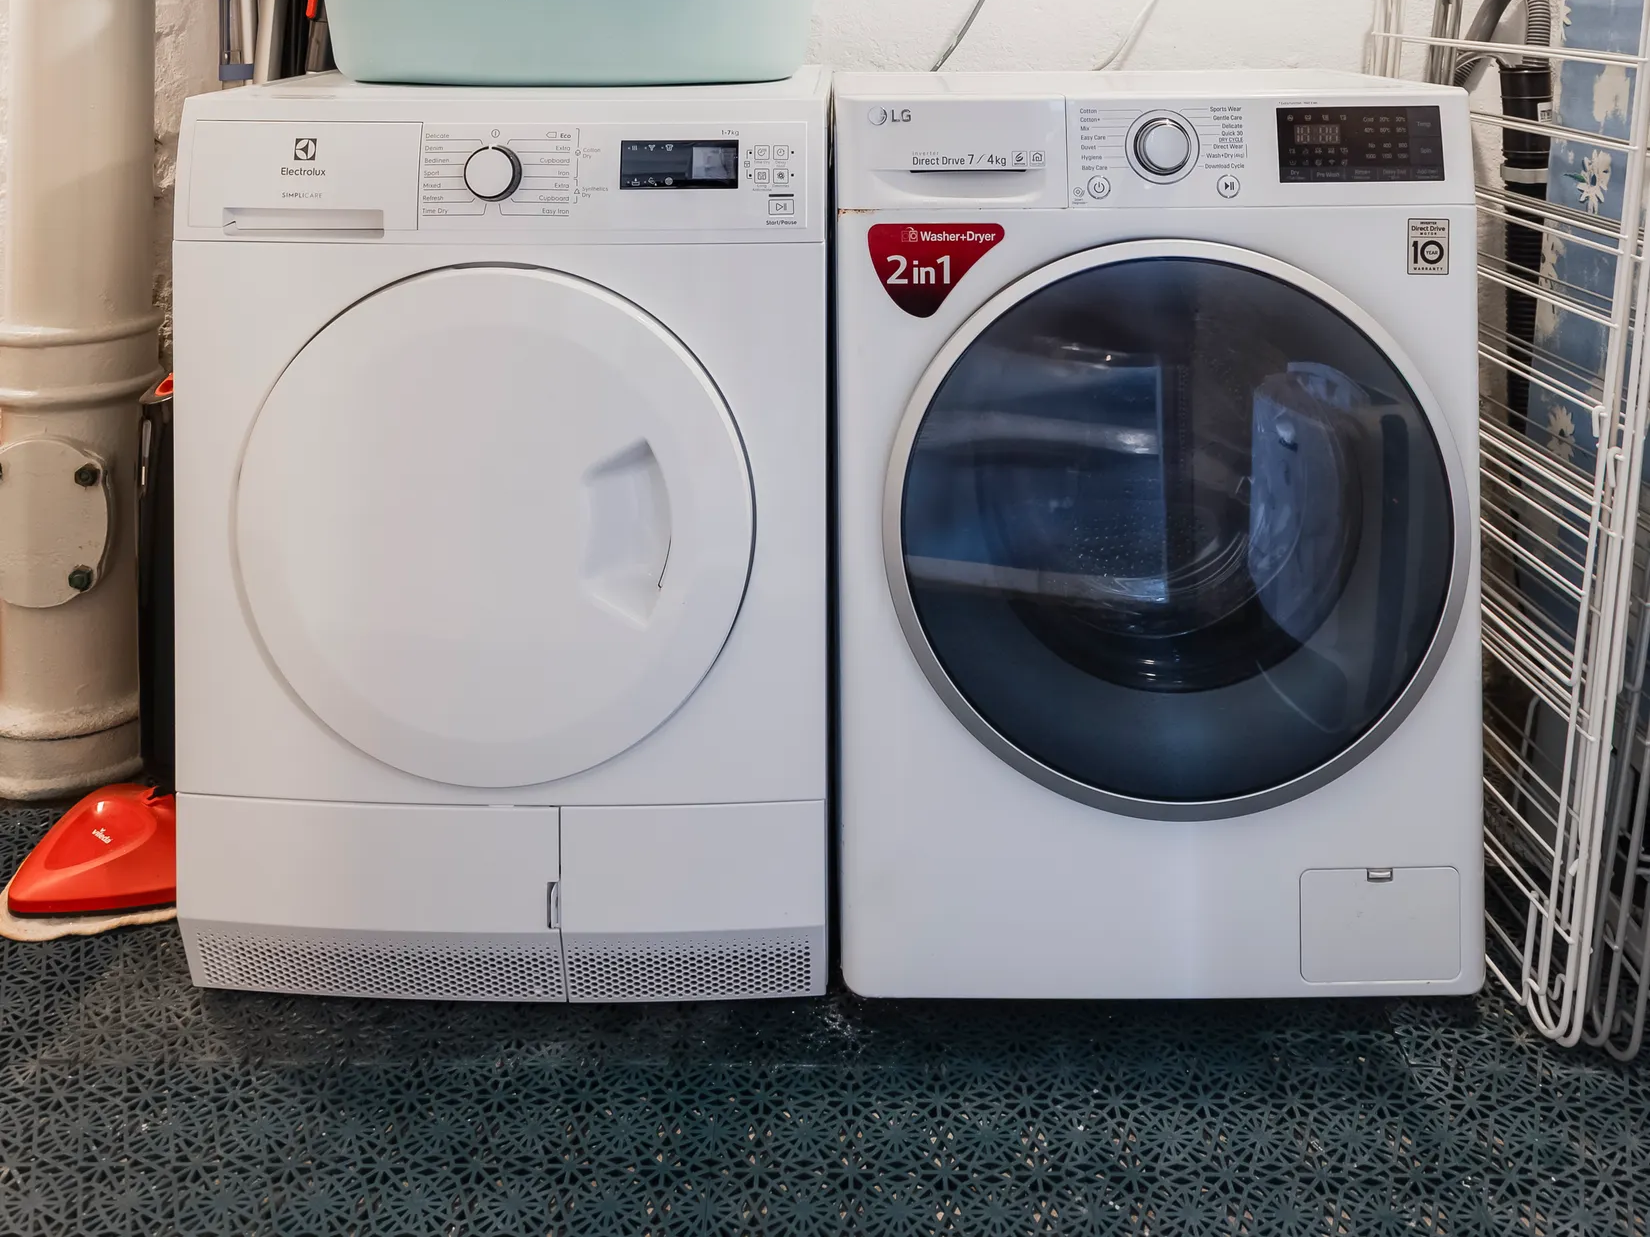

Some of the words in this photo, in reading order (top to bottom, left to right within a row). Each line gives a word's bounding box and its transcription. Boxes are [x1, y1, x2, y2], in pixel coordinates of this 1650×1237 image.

[891, 109, 912, 123] LG
[912, 156, 940, 166] Direct
[942, 156, 965, 166] Drive
[280, 167, 326, 176] Electrolux
[542, 207, 556, 215] Easy
[920, 230, 996, 244] Washer+Dryer
[1411, 240, 1444, 265] 10
